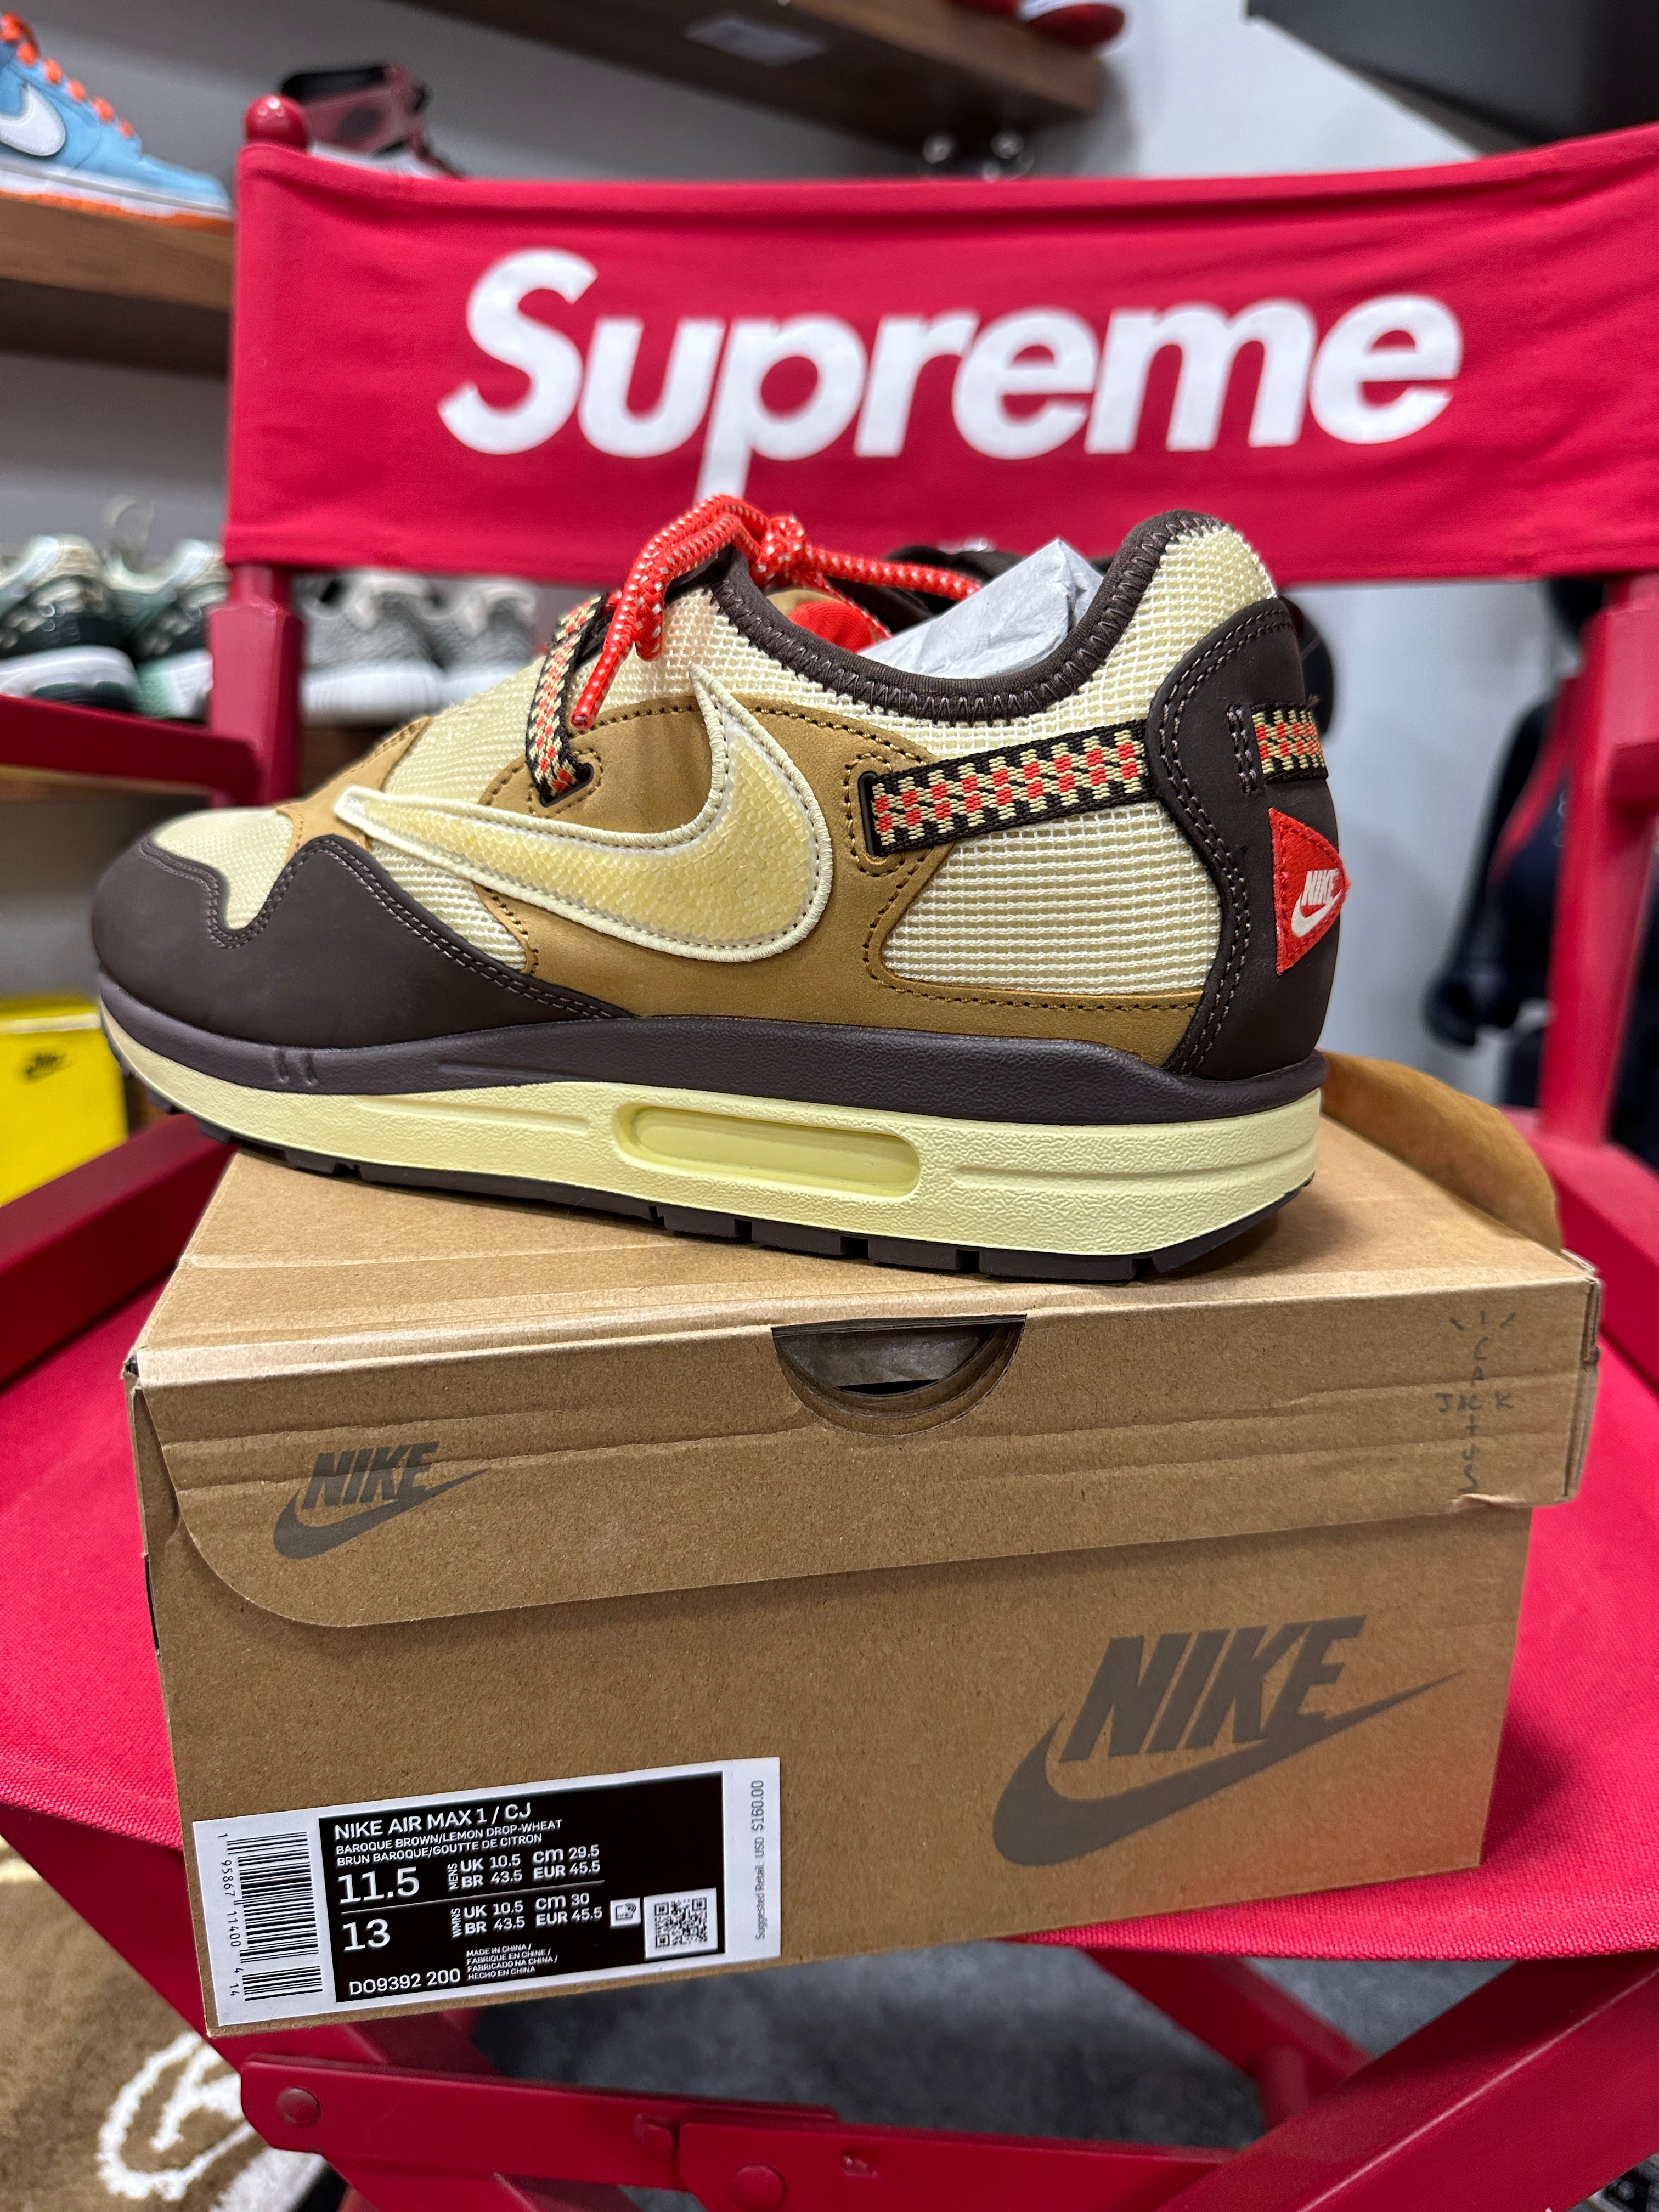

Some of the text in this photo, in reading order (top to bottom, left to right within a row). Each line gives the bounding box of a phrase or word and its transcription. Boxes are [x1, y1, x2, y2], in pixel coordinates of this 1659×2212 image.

[436, 245, 1464, 498] Supreme
[1301, 868, 1339, 906] NIKE
[301, 1441, 439, 1510] NIKE
[1058, 1615, 1367, 1763] NIKE
[334, 1820, 383, 1840] NIKE
[387, 1816, 422, 1836] AIR
[427, 1809, 472, 1831] MAX
[476, 1808, 487, 1823] 1
[505, 1802, 531, 1821] CJ
[751, 1779, 765, 1831] $160.00
[335, 1819, 563, 1855] BAROQUE BROWN/LEMON DROP-WHEAT
[336, 1833, 542, 1866] BRUN BAROQUE/GOUTTE DE CITRON
[754, 1836, 765, 1859] USD
[460, 1844, 600, 1873] UK 10.5 cm 29.5
[461, 1860, 601, 1889] BR 43.5 EUR 45.5
[221, 1859, 236, 1897] 95867
[338, 1866, 420, 1904] 11.5
[447, 1863, 459, 1891] MENS
[463, 1892, 590, 1920] UK 10.5 cm 30
[464, 1906, 603, 1935] BR 43.5 EUR 45.5
[755, 1892, 768, 1941] Suggested
[227, 1910, 241, 1947] 11400
[342, 1918, 391, 1951] 13
[450, 1908, 462, 1939] WMNS
[466, 1948, 490, 1957] MADE
[502, 1944, 527, 1953] CHINA
[466, 1954, 507, 1965] FABRIQUE
[509, 1951, 520, 1960] EN
[521, 1948, 546, 1959] CHINE
[426, 1968, 461, 1986] 200
[466, 1961, 514, 1973] FABRICADO
[467, 1970, 496, 1980] HECHO
[511, 1966, 536, 1975] CHINA
[229, 1983, 240, 1996] 14
